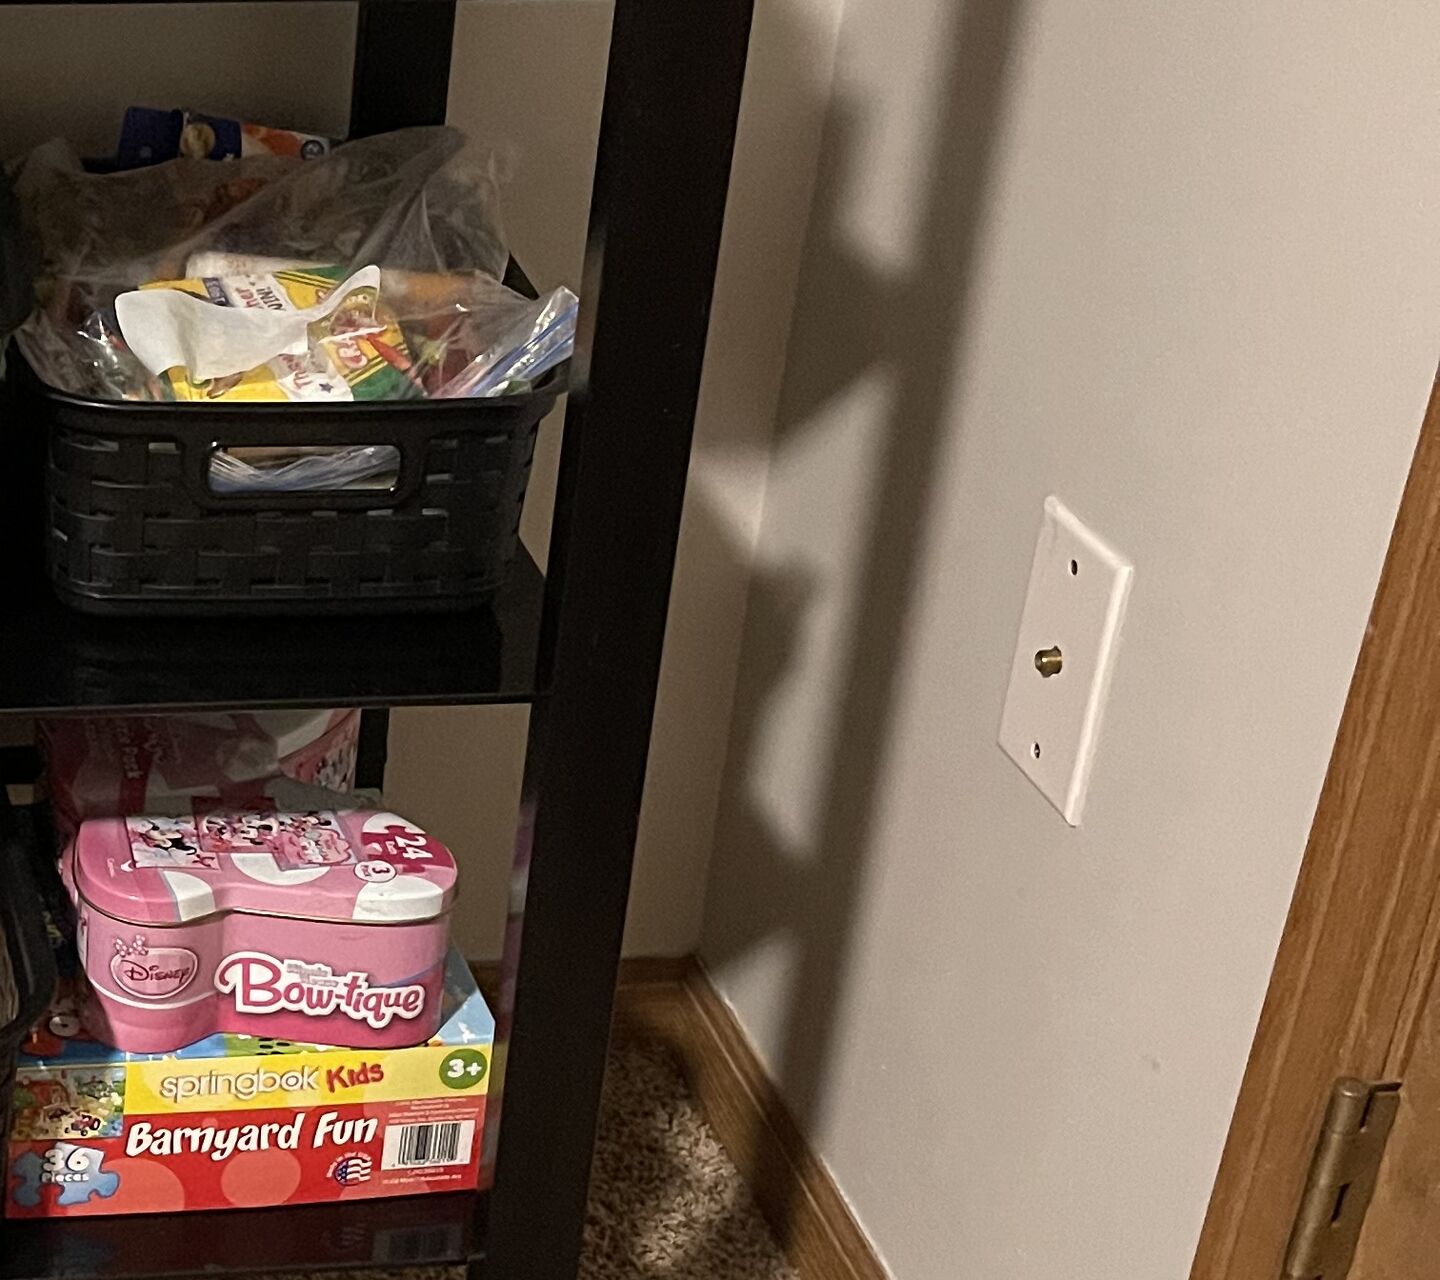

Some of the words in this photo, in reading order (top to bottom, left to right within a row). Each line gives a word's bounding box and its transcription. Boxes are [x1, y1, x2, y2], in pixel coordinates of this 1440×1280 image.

[394, 835, 434, 860] 24
[446, 1058, 483, 1078] 3+
[159, 1065, 321, 1104] springbok
[326, 1061, 385, 1093] Kids
[125, 1112, 307, 1161] Barnyard
[312, 1111, 379, 1149] Fun
[42, 1147, 90, 1171] 36
[41, 1170, 90, 1183] Pieces
